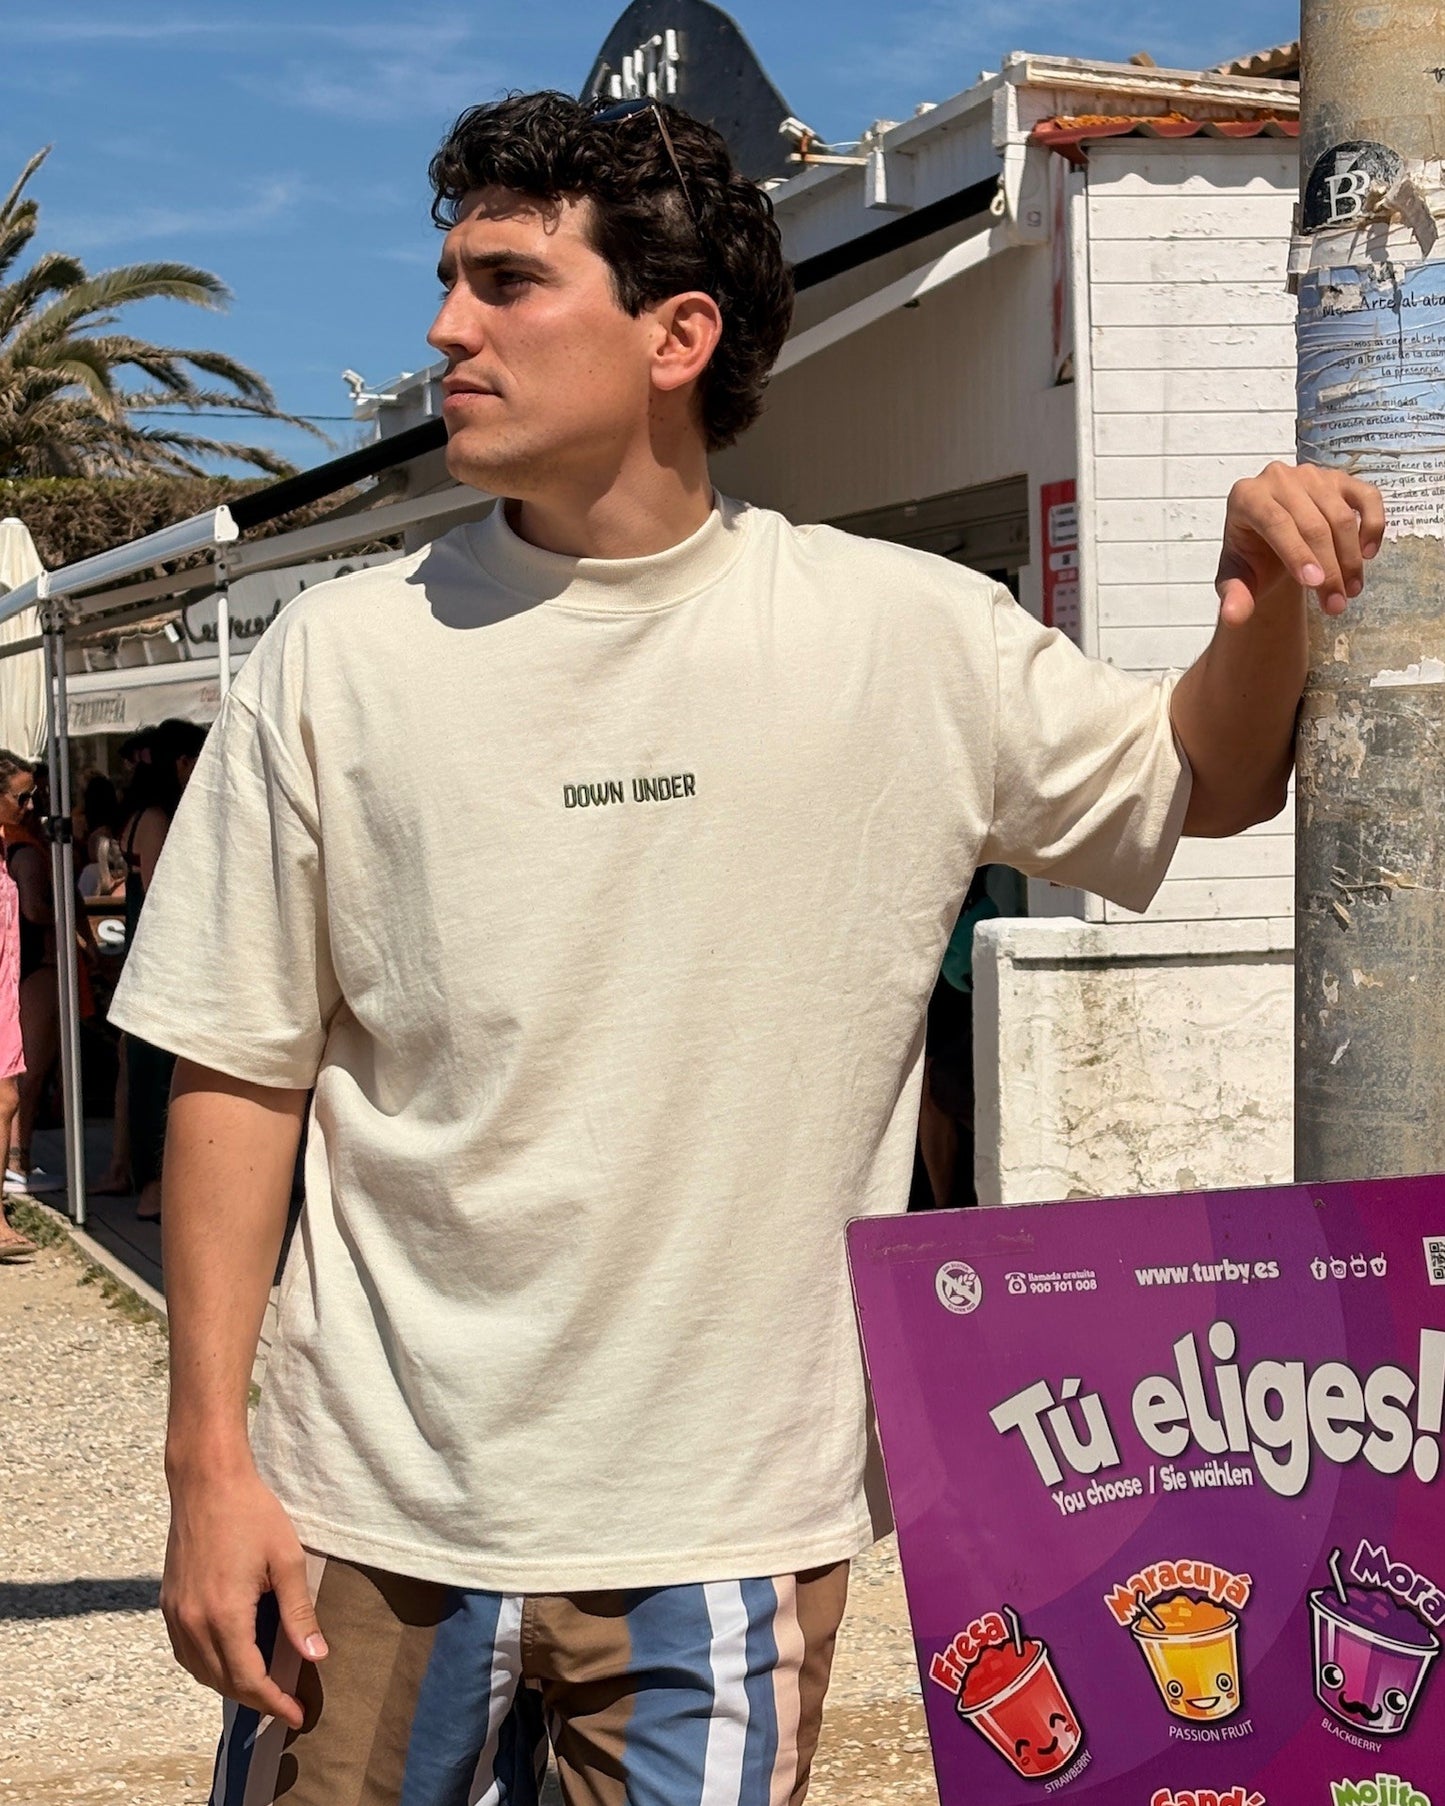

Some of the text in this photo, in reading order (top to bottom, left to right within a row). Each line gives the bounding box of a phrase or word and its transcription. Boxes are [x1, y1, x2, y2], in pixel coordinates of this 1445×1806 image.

[1361, 295, 1396, 310] Arte
[1402, 291, 1417, 308] al
[1381, 366, 1392, 377] la
[1399, 475, 1417, 488] que
[1385, 503, 1434, 515] xperiencia
[563, 772, 696, 808] DOWN UNDER
[1029, 1279, 1098, 1294] 900 701 008
[1134, 1258, 1281, 1286] www.turby.es
[988, 1321, 1445, 1496] Tú eliges!
[1052, 1490, 1087, 1516] You
[1086, 1477, 1143, 1506] choose
[1159, 1464, 1187, 1492] Sie
[1190, 1460, 1254, 1488] wählen
[1104, 1559, 1252, 1626] Maracuyá
[1350, 1538, 1445, 1626] Mora
[929, 1611, 1010, 1695] Fresa
[1169, 1720, 1254, 1742] PASSION FRUIT
[1321, 1717, 1382, 1753] BLACKBERRY
[1044, 1749, 1093, 1793] STRAWBERRY
